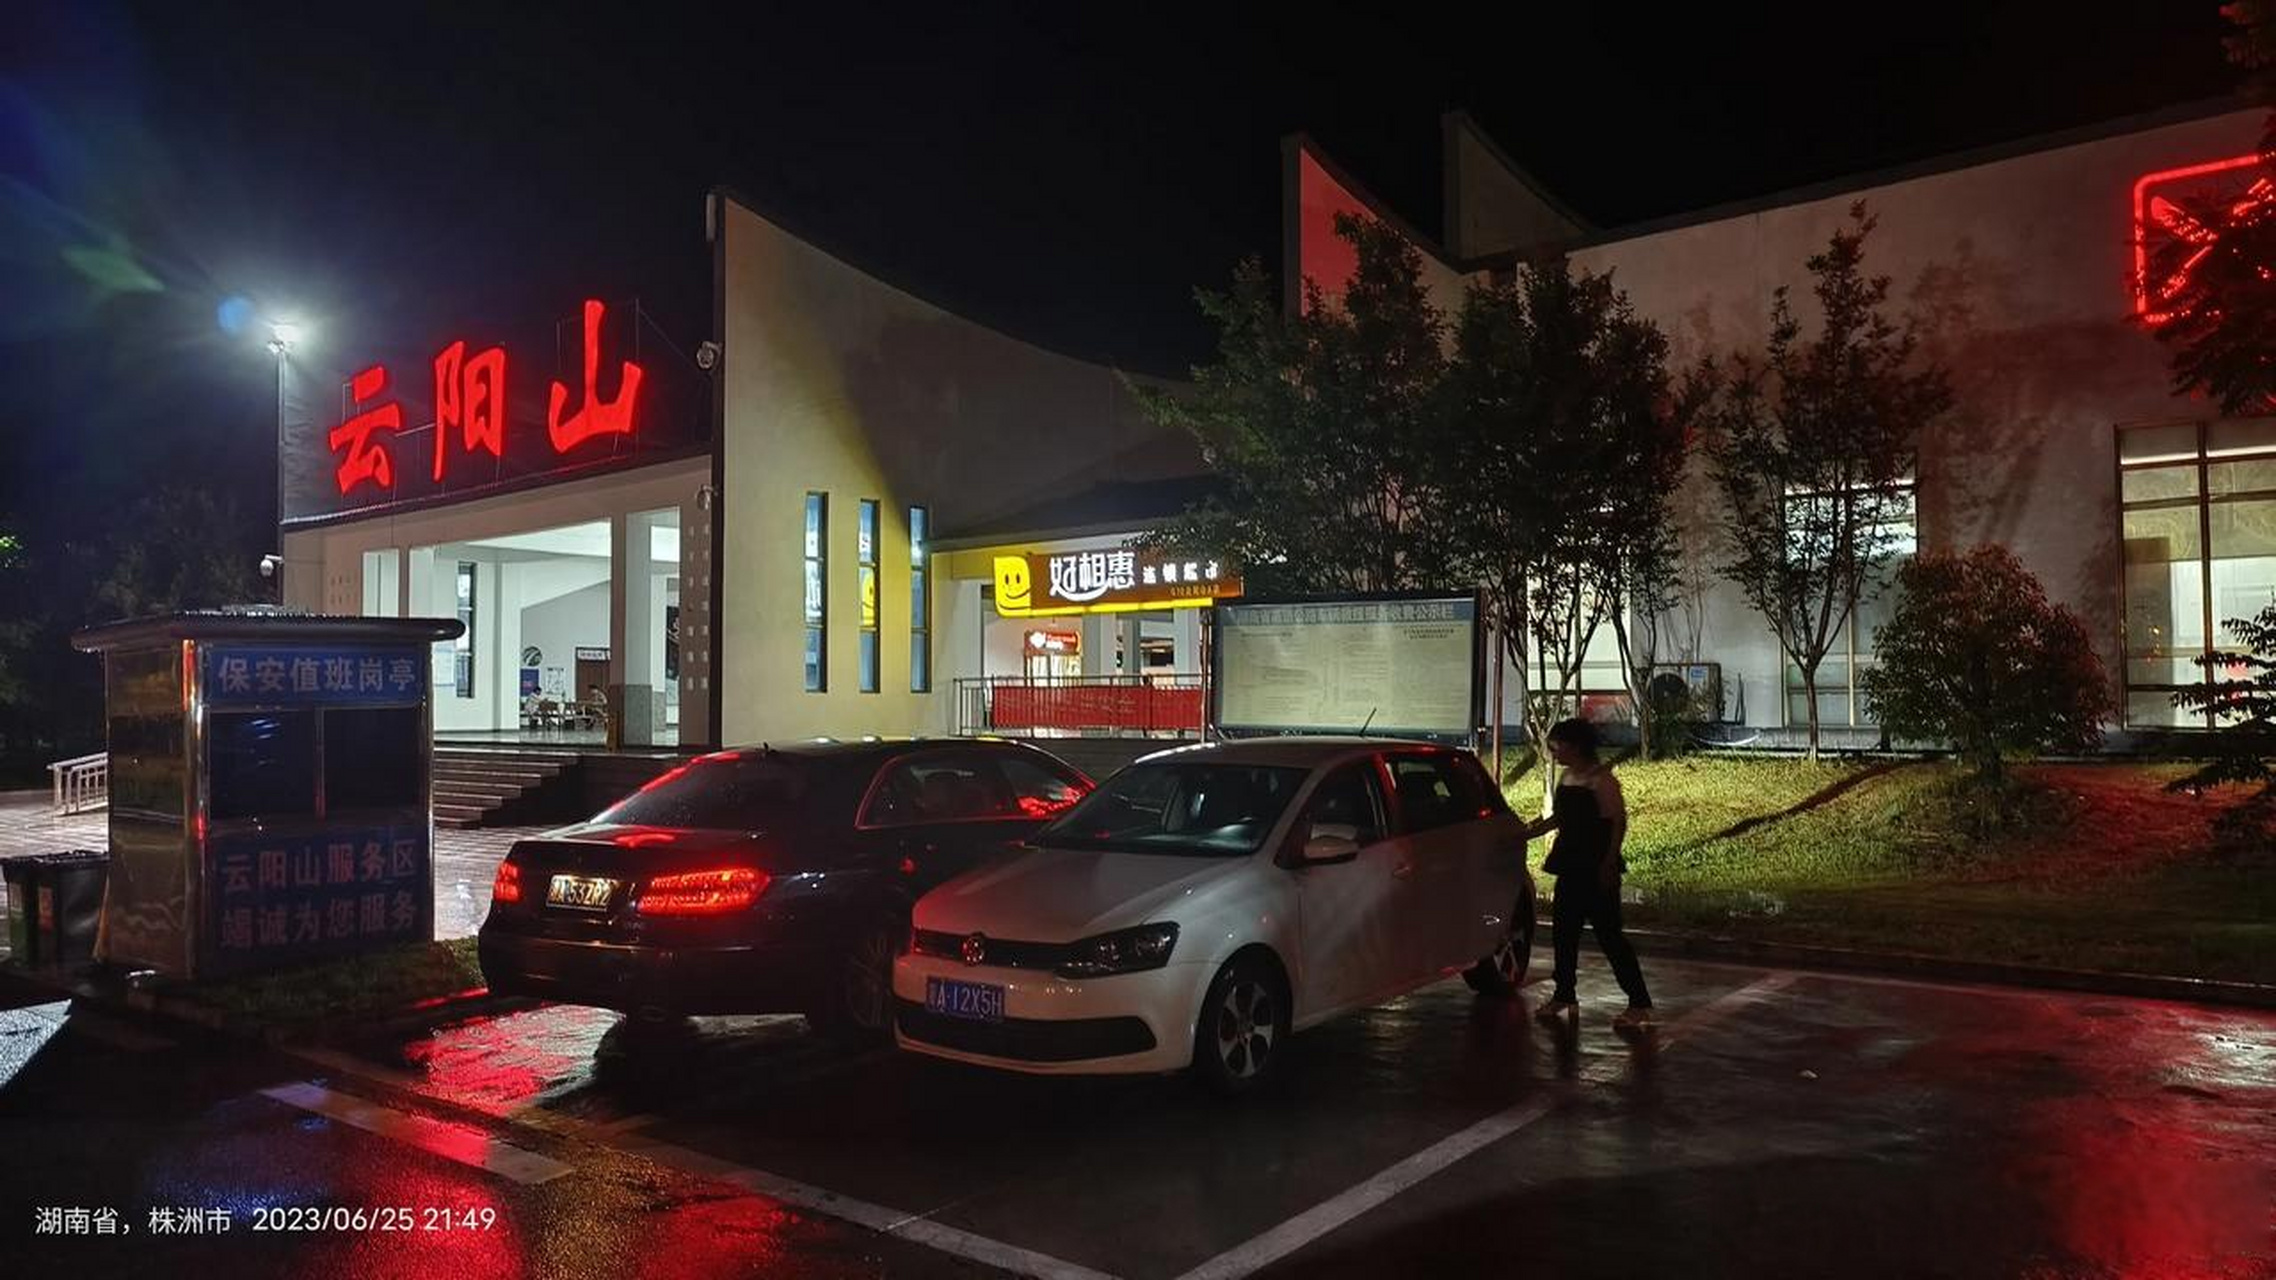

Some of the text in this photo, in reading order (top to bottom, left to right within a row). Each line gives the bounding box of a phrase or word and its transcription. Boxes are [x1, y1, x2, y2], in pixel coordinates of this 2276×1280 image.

[329, 299, 643, 494] 云阳山
[1049, 550, 1136, 602] 好相惠
[218, 655, 416, 693] 保安值班岗亭
[222, 838, 417, 893] 云阳山服务区
[219, 890, 418, 949] 竭诚为您服务
